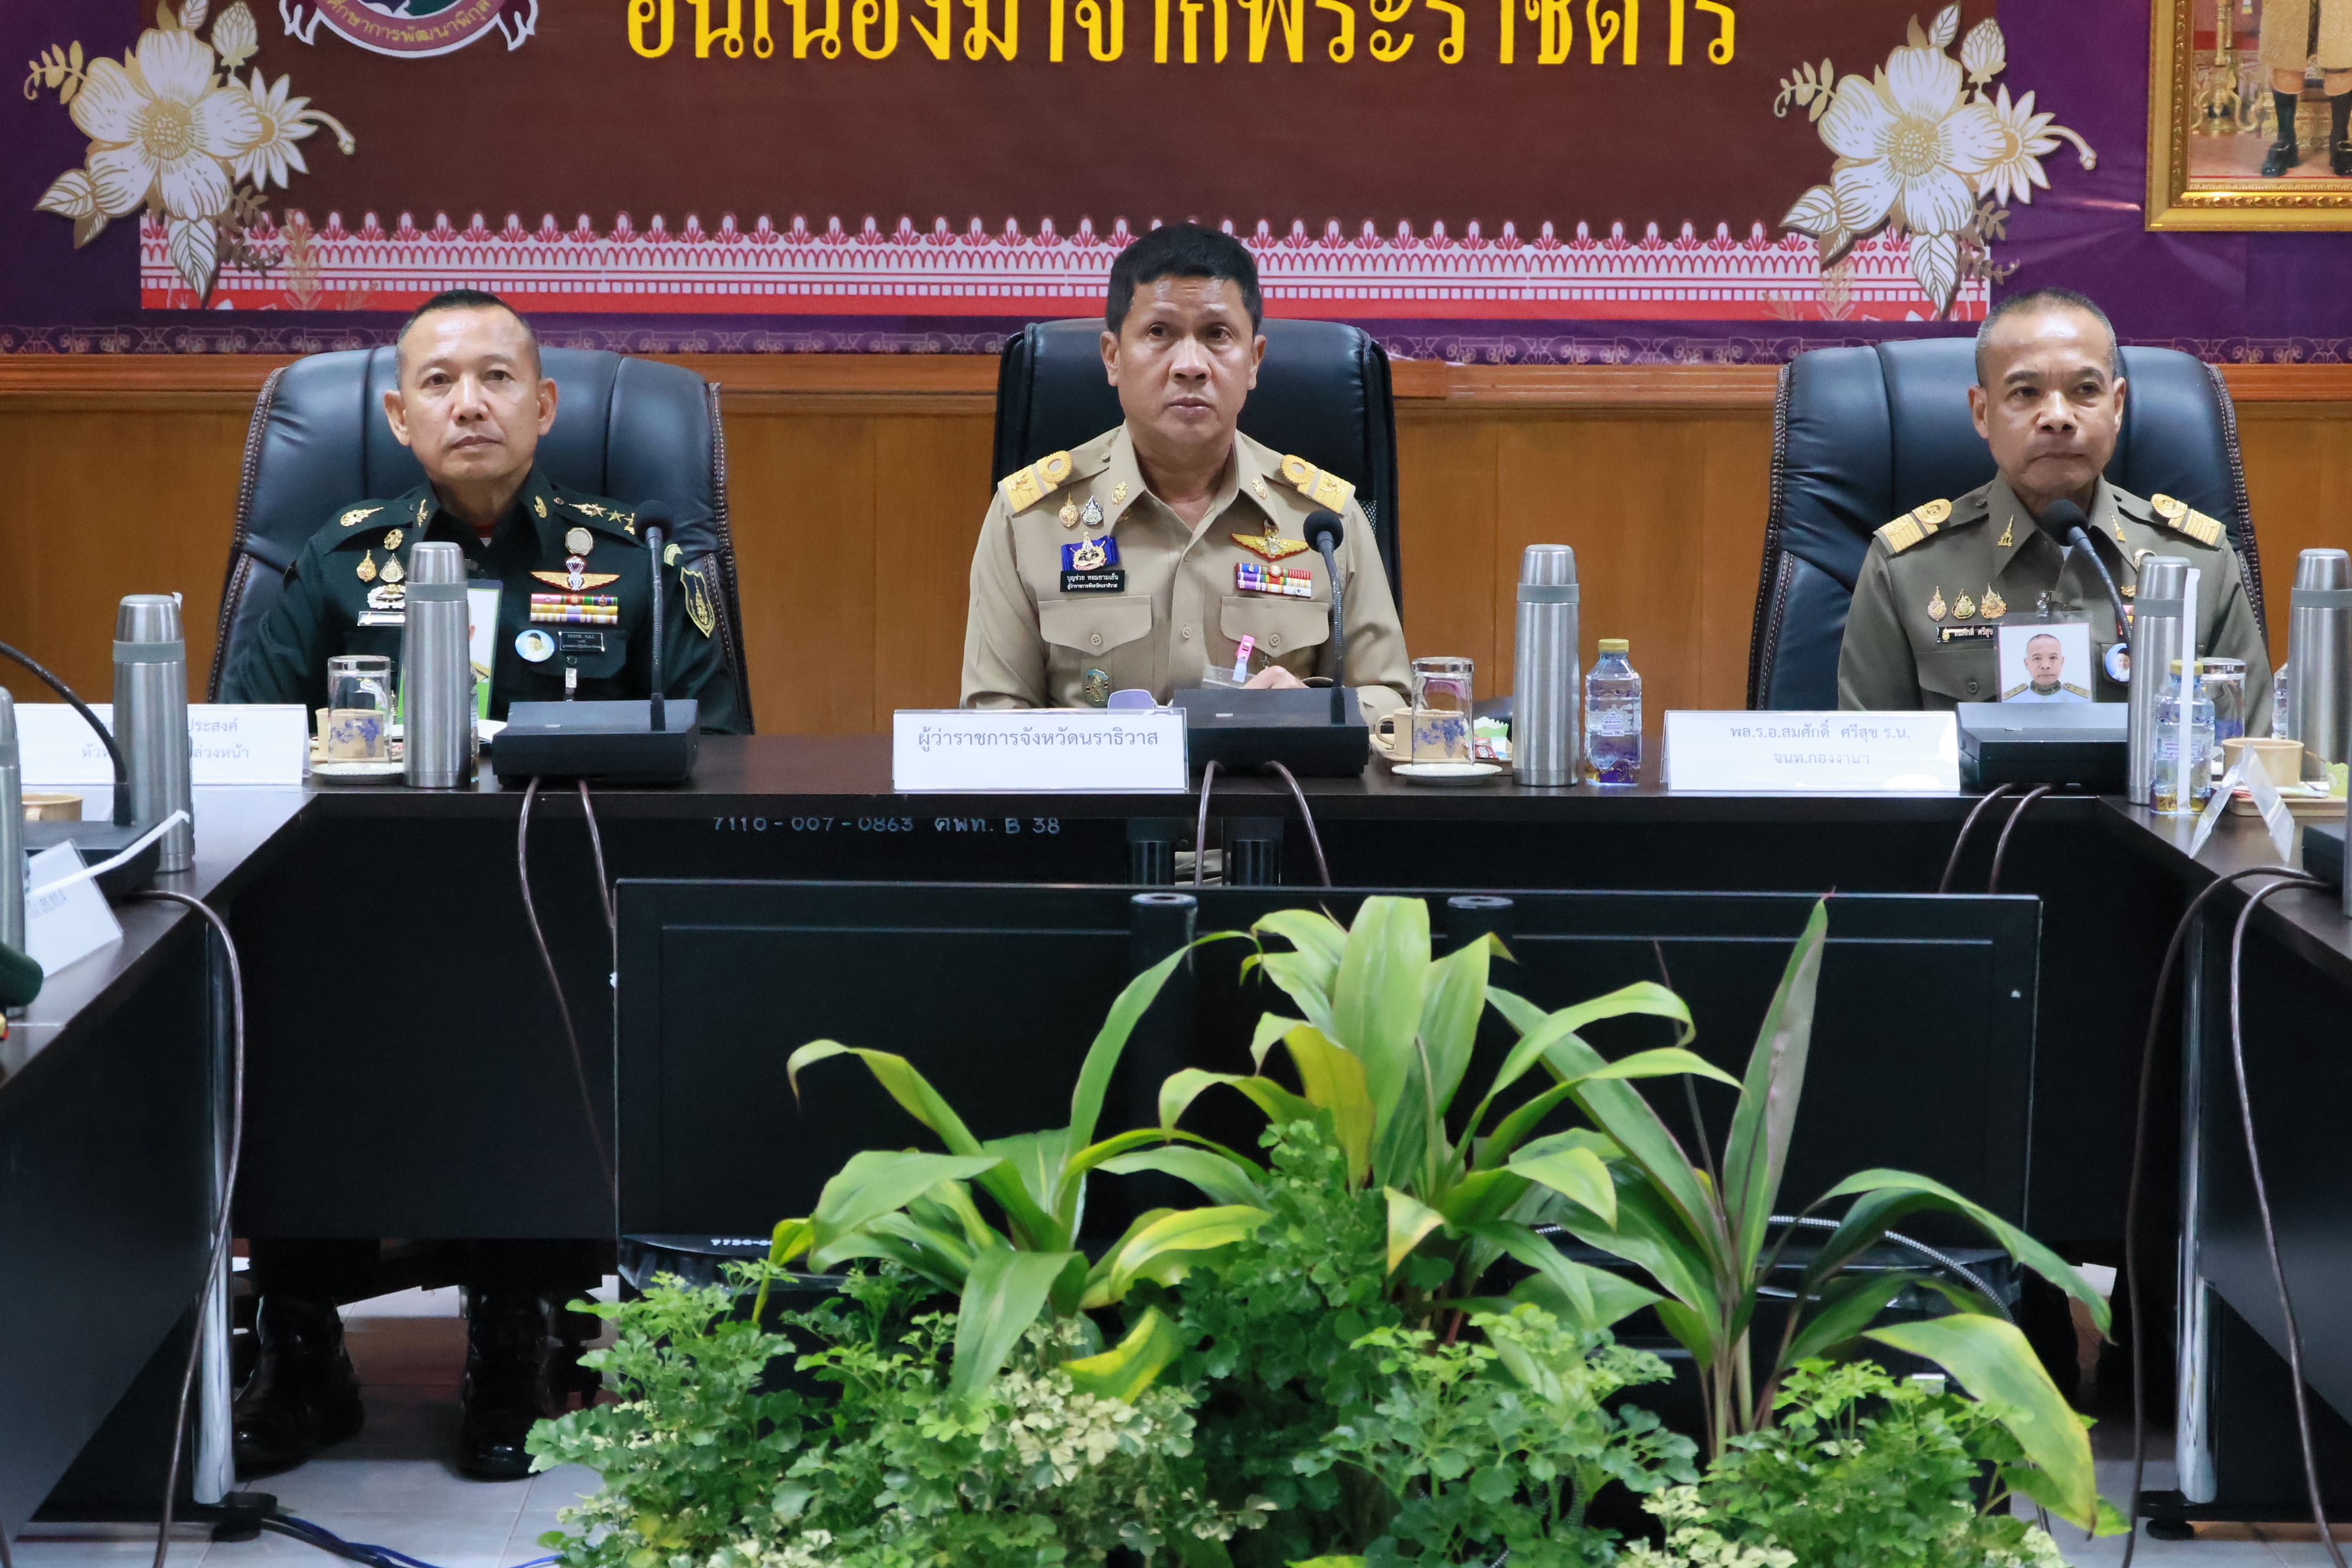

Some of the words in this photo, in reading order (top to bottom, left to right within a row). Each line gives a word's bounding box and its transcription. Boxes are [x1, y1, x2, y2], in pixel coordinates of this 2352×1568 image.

[919, 726, 1158, 753] ผู้ว่าราชการจังหวัดนราธิวาส
[1730, 718, 1830, 738] พล.ร.อ.สมศักดิ์
[1841, 723, 1878, 743] ศรีสุข
[1884, 727, 1910, 738] ร.น.
[1005, 817, 1021, 834] B
[1033, 817, 1060, 834] 38
